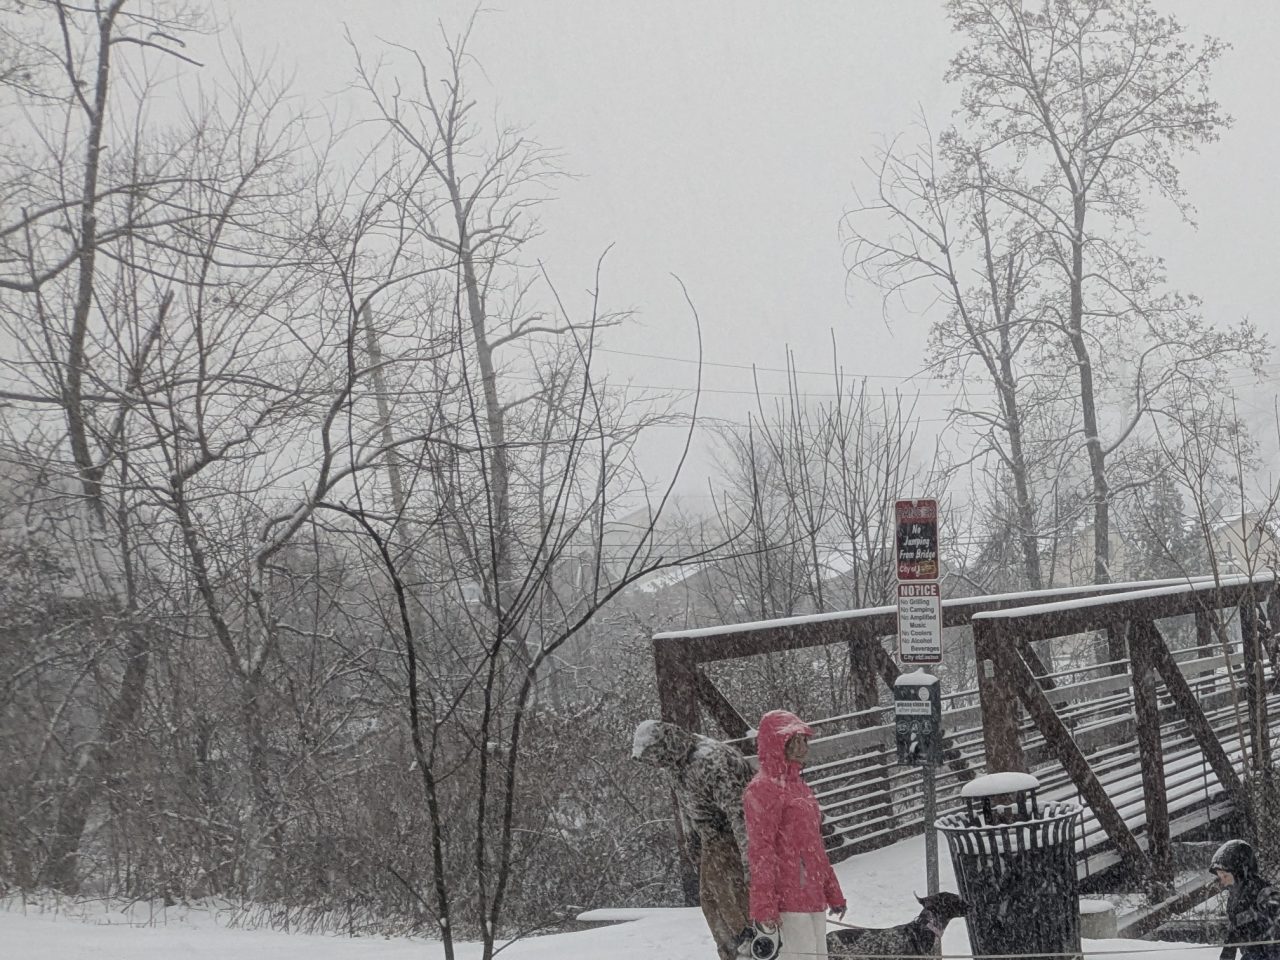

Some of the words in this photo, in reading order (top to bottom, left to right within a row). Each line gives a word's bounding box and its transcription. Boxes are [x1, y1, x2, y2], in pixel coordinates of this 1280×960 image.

[912, 524, 921, 534] No
[903, 536, 930, 548] Jumping
[900, 550, 914, 559] From
[915, 549, 936, 561] Bridge
[900, 566, 910, 574] City
[900, 585, 937, 596] NOTICE
